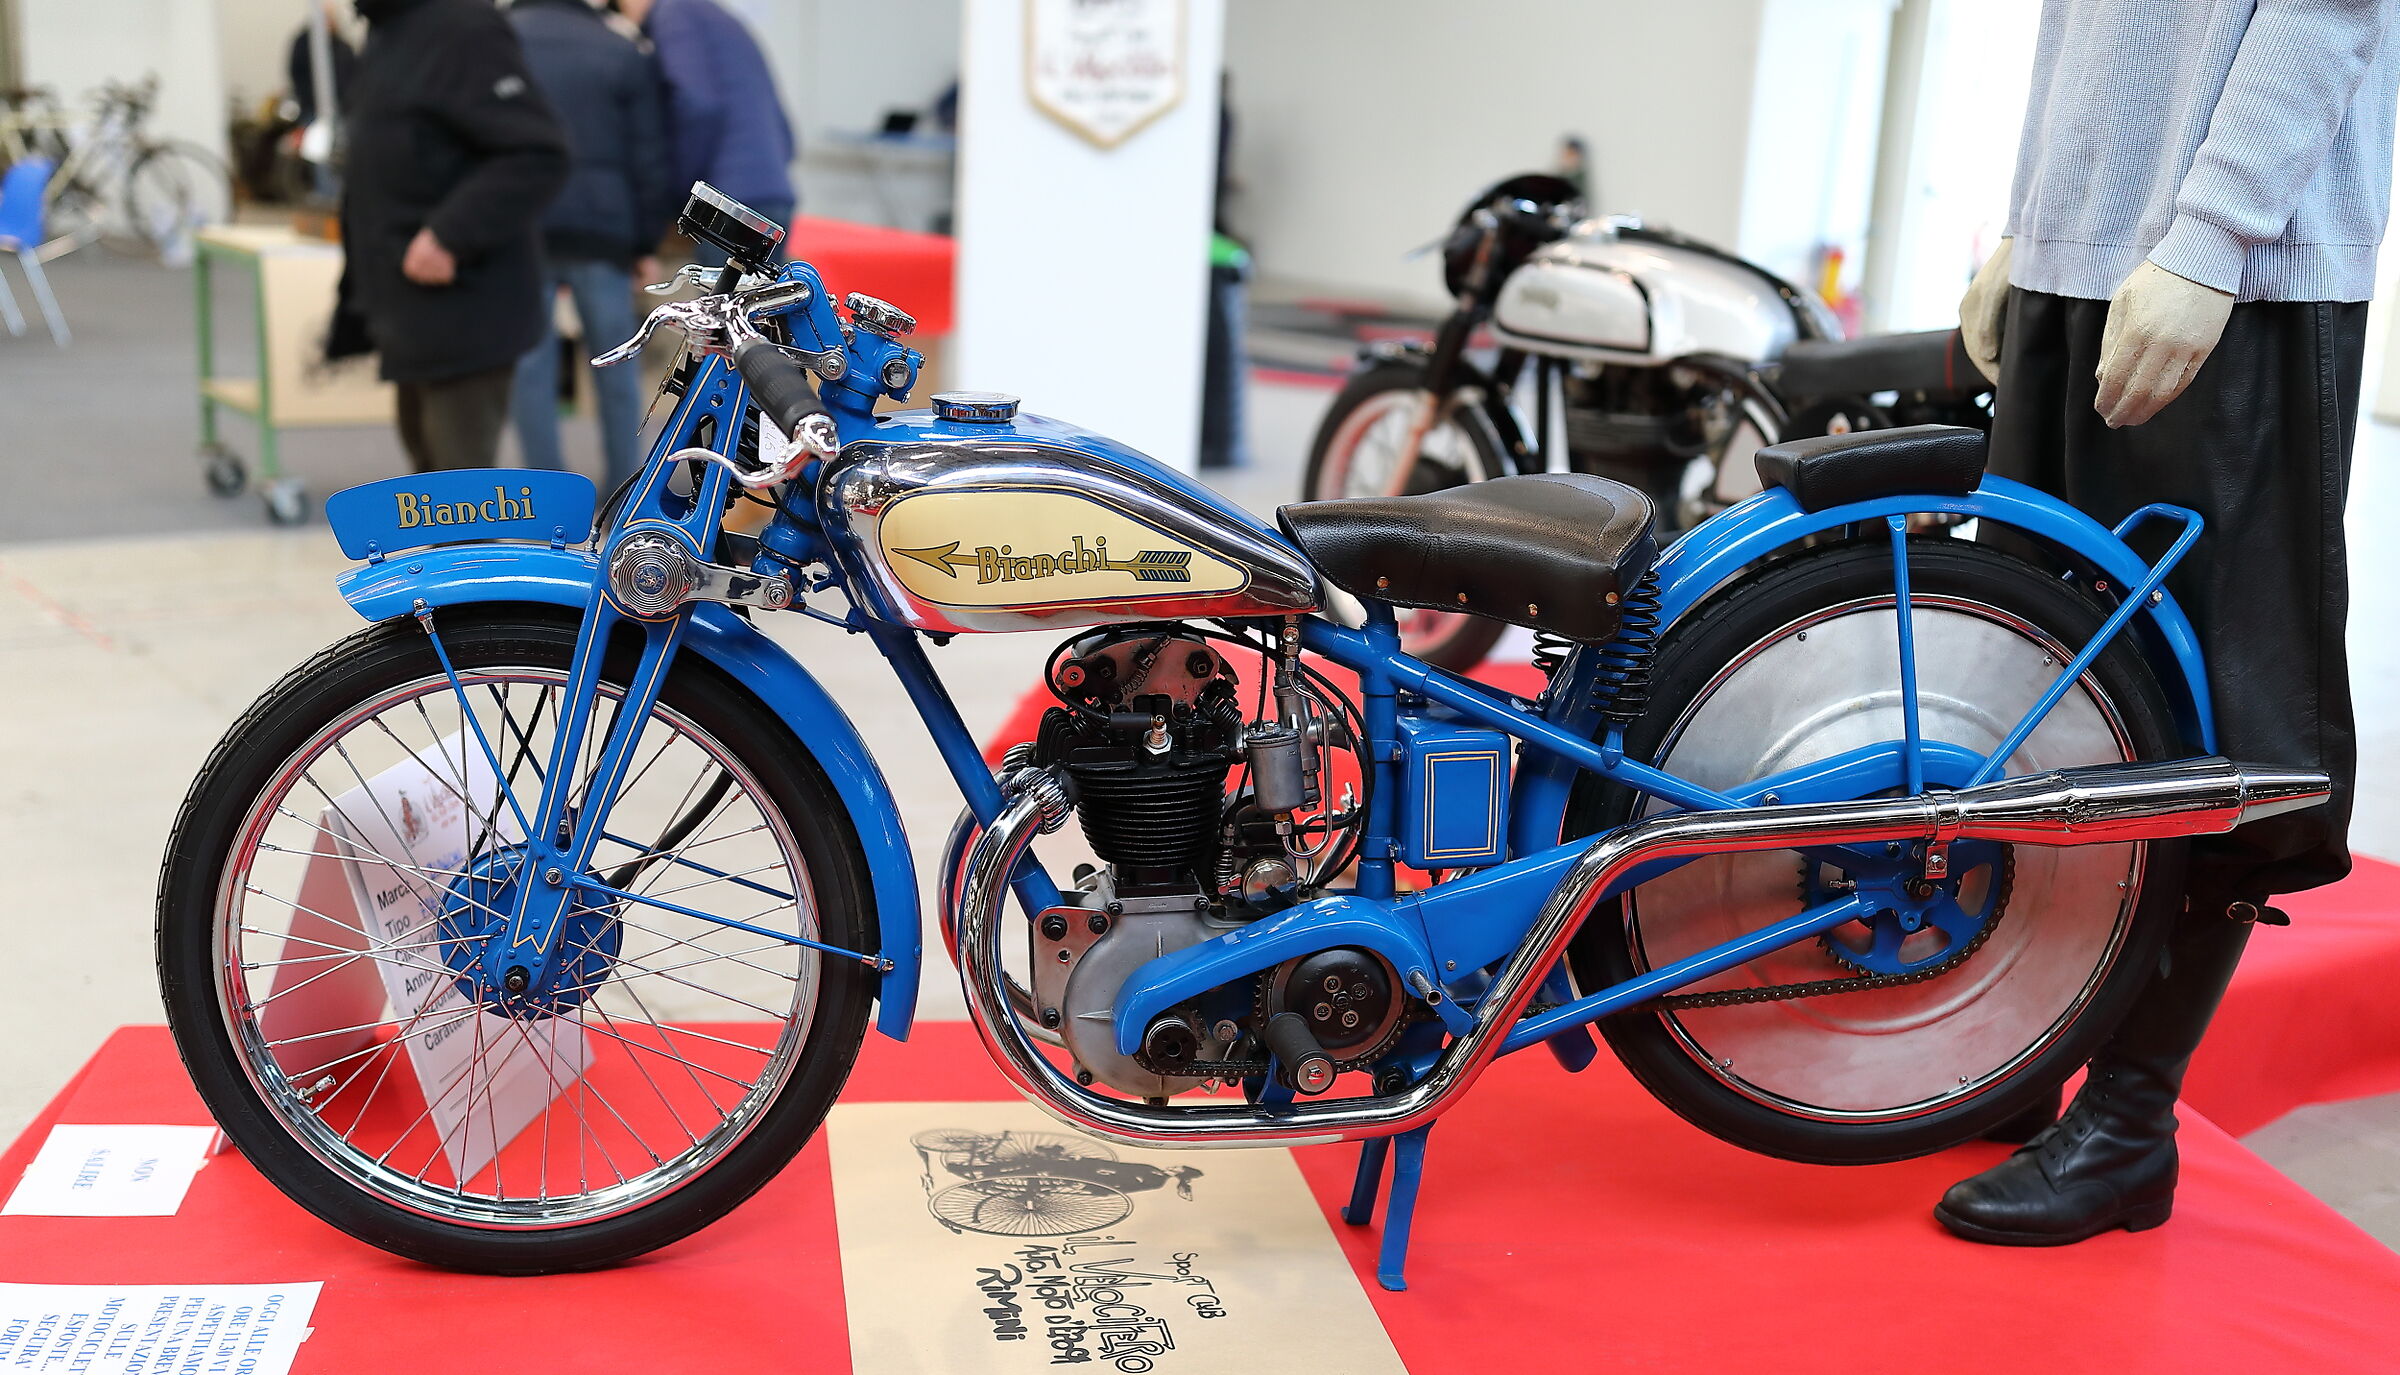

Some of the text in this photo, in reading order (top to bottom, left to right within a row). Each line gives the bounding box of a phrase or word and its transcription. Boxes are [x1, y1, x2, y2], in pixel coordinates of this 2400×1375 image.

[394, 485, 536, 530] Bianchi
[974, 535, 1111, 585] Bianchi
[385, 914, 411, 938] Tipo
[72, 1149, 111, 1190] SALIRE
[131, 1158, 159, 1182] NON
[180, 1297, 206, 1318] PER
[258, 1294, 285, 1322] OGGI
[68, 1297, 127, 1375] MOTOCICLET
[104, 1323, 138, 1359] SULLE
[167, 1320, 193, 1344] UNA
[208, 1306, 253, 1372] ORE 11.30 VI
[243, 1325, 270, 1355] ALLE
